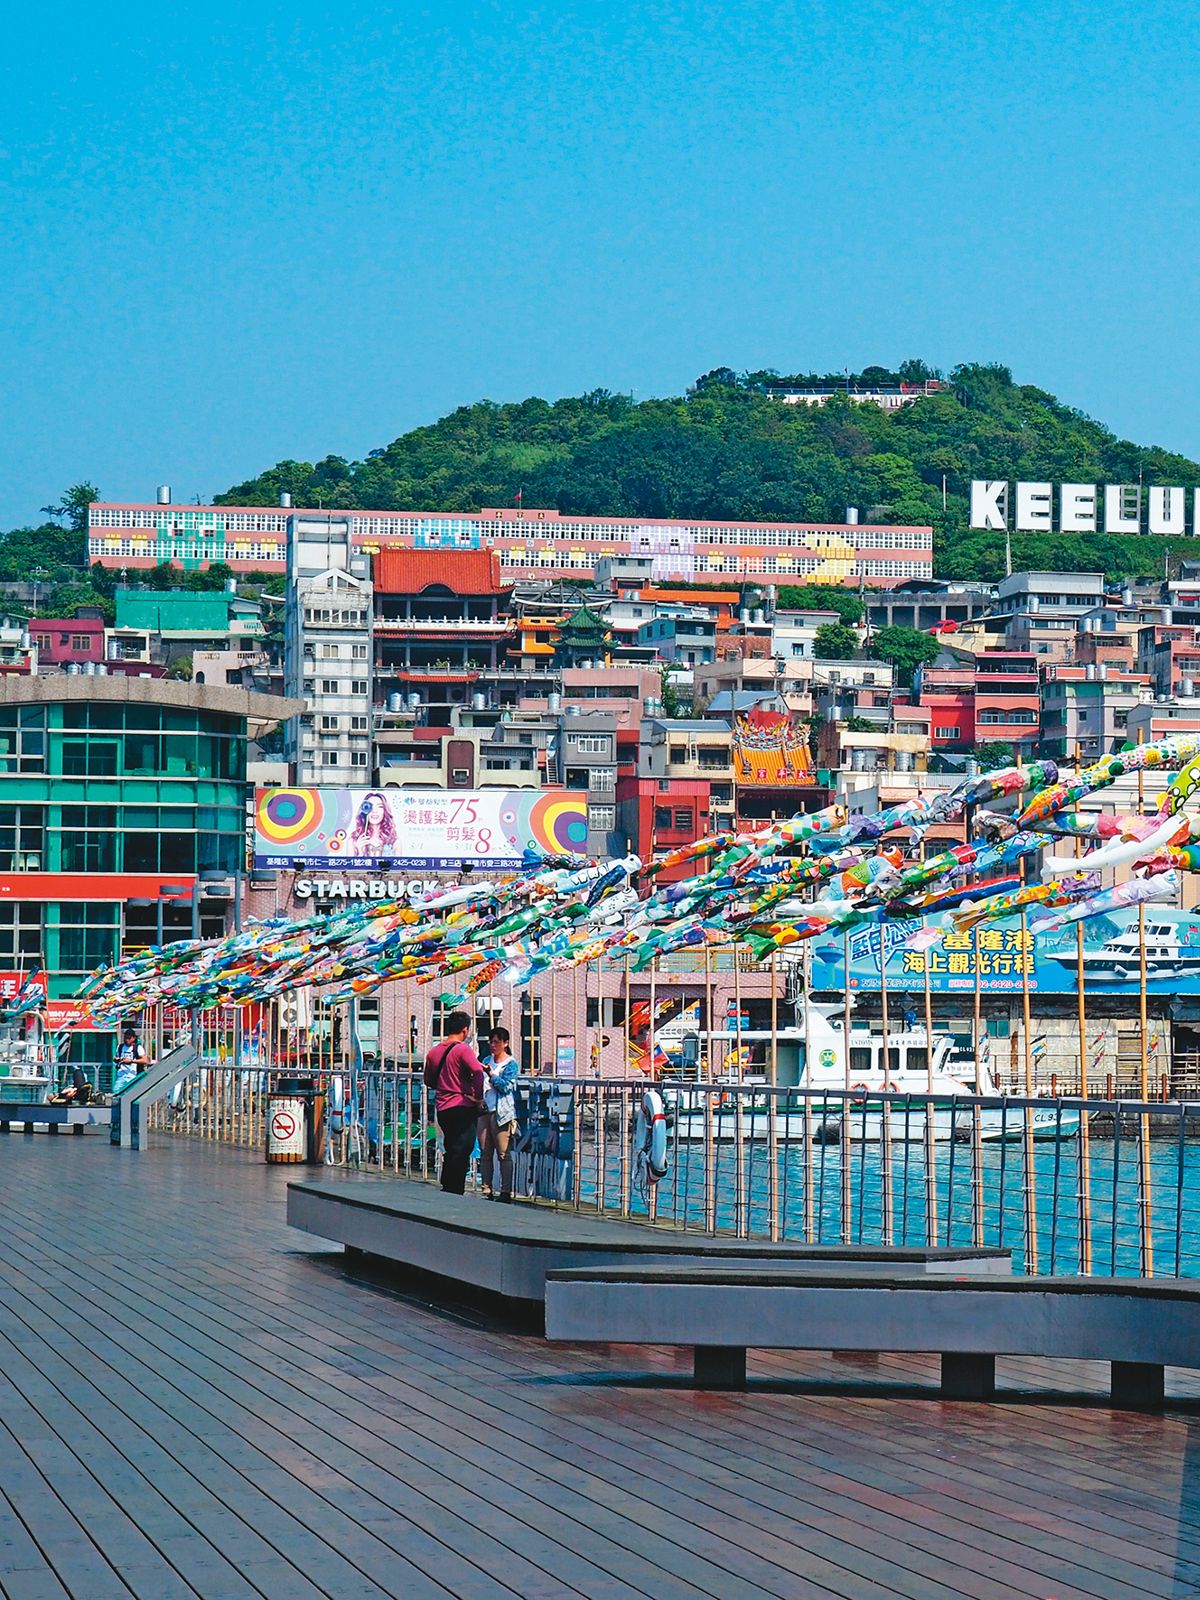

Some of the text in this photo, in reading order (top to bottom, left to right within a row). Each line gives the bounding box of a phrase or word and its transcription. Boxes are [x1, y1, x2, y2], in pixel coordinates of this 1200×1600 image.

[449, 797, 480, 824] 75
[475, 828, 492, 853] 8
[942, 929, 1034, 951] 基隆港
[902, 951, 1036, 975] 海上觀光行程
